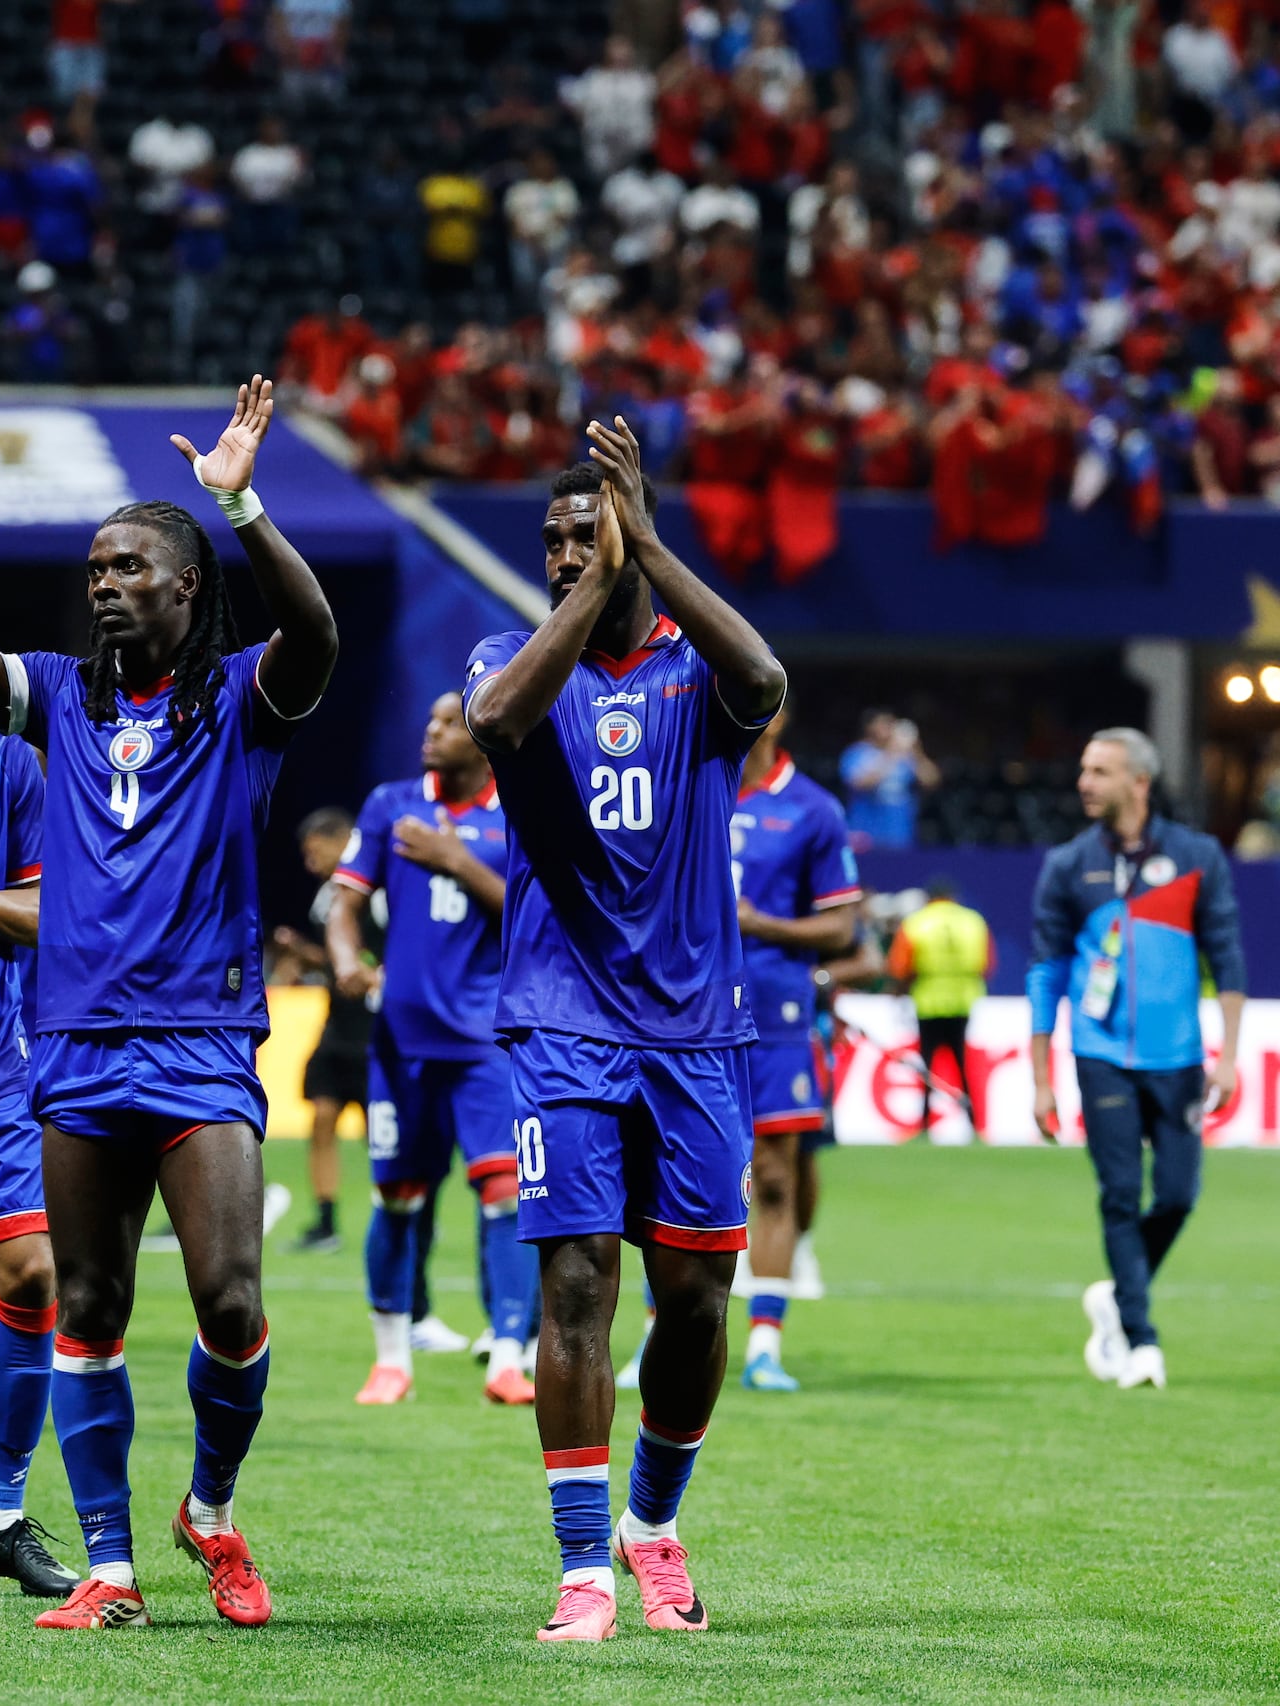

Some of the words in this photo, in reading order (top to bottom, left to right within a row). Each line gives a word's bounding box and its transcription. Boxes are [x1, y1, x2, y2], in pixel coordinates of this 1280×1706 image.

[592, 692, 646, 707] SAETA
[110, 772, 139, 830] 4
[589, 765, 653, 830] 20
[428, 875, 468, 923] 16
